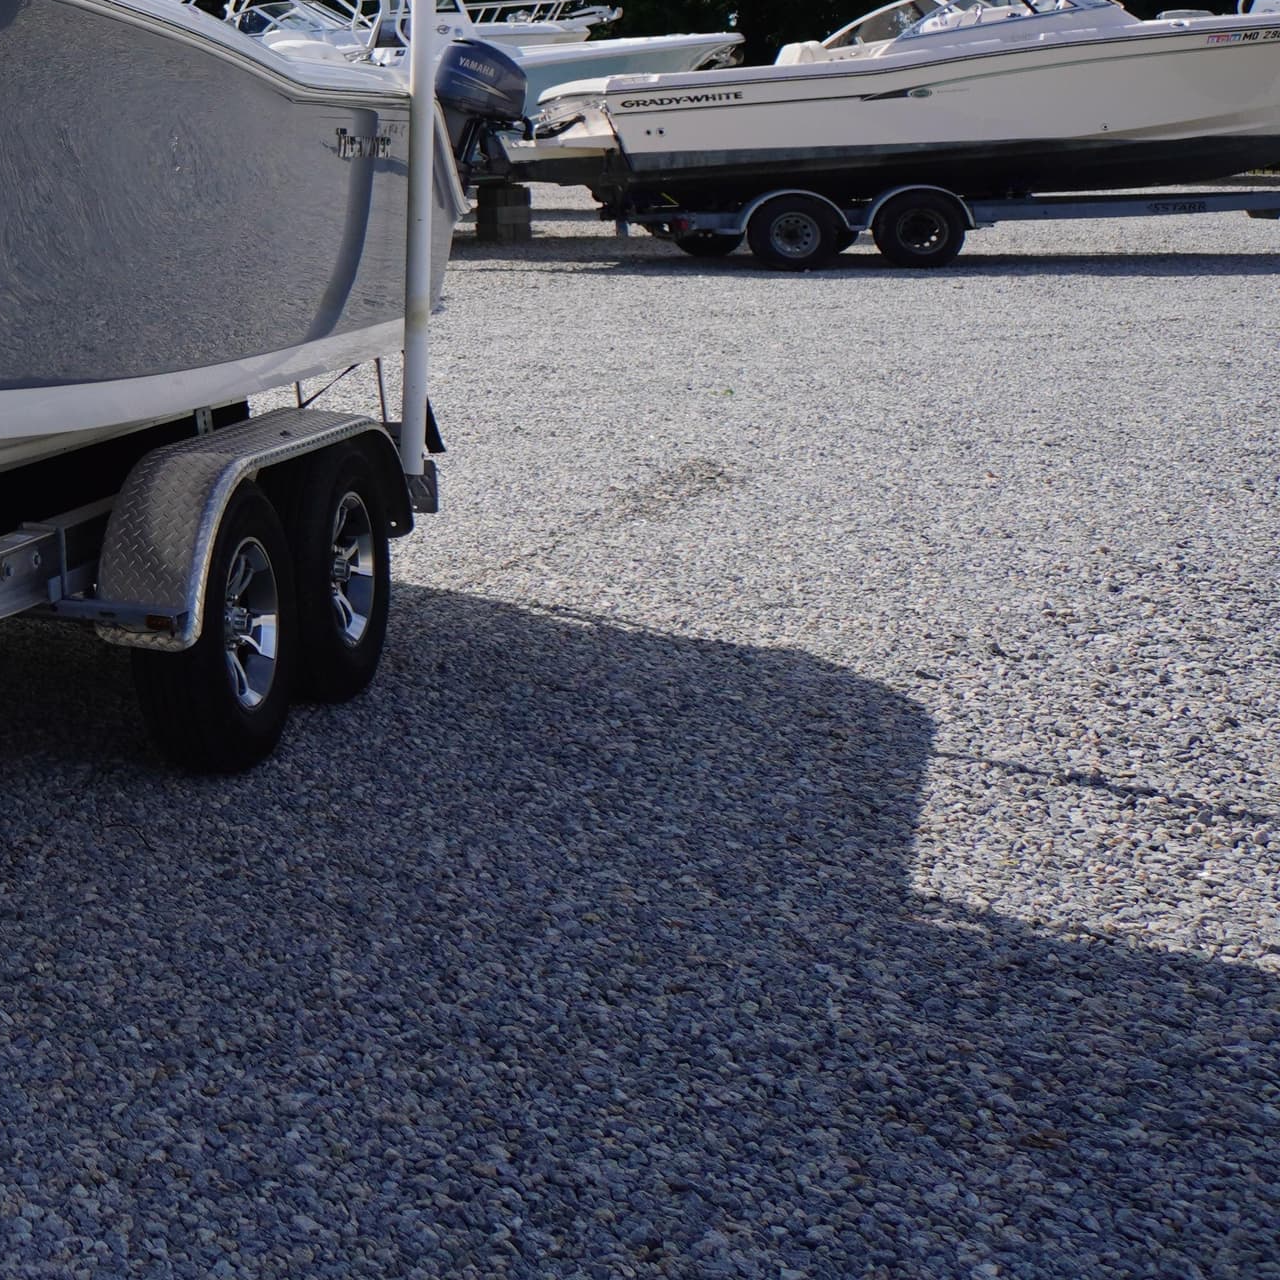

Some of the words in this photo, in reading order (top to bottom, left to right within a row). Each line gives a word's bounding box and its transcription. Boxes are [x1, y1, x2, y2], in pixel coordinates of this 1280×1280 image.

[1243, 32, 1260, 41] MD
[459, 55, 495, 78] YAMAHA
[620, 91, 744, 108] GRADY-WHITE
